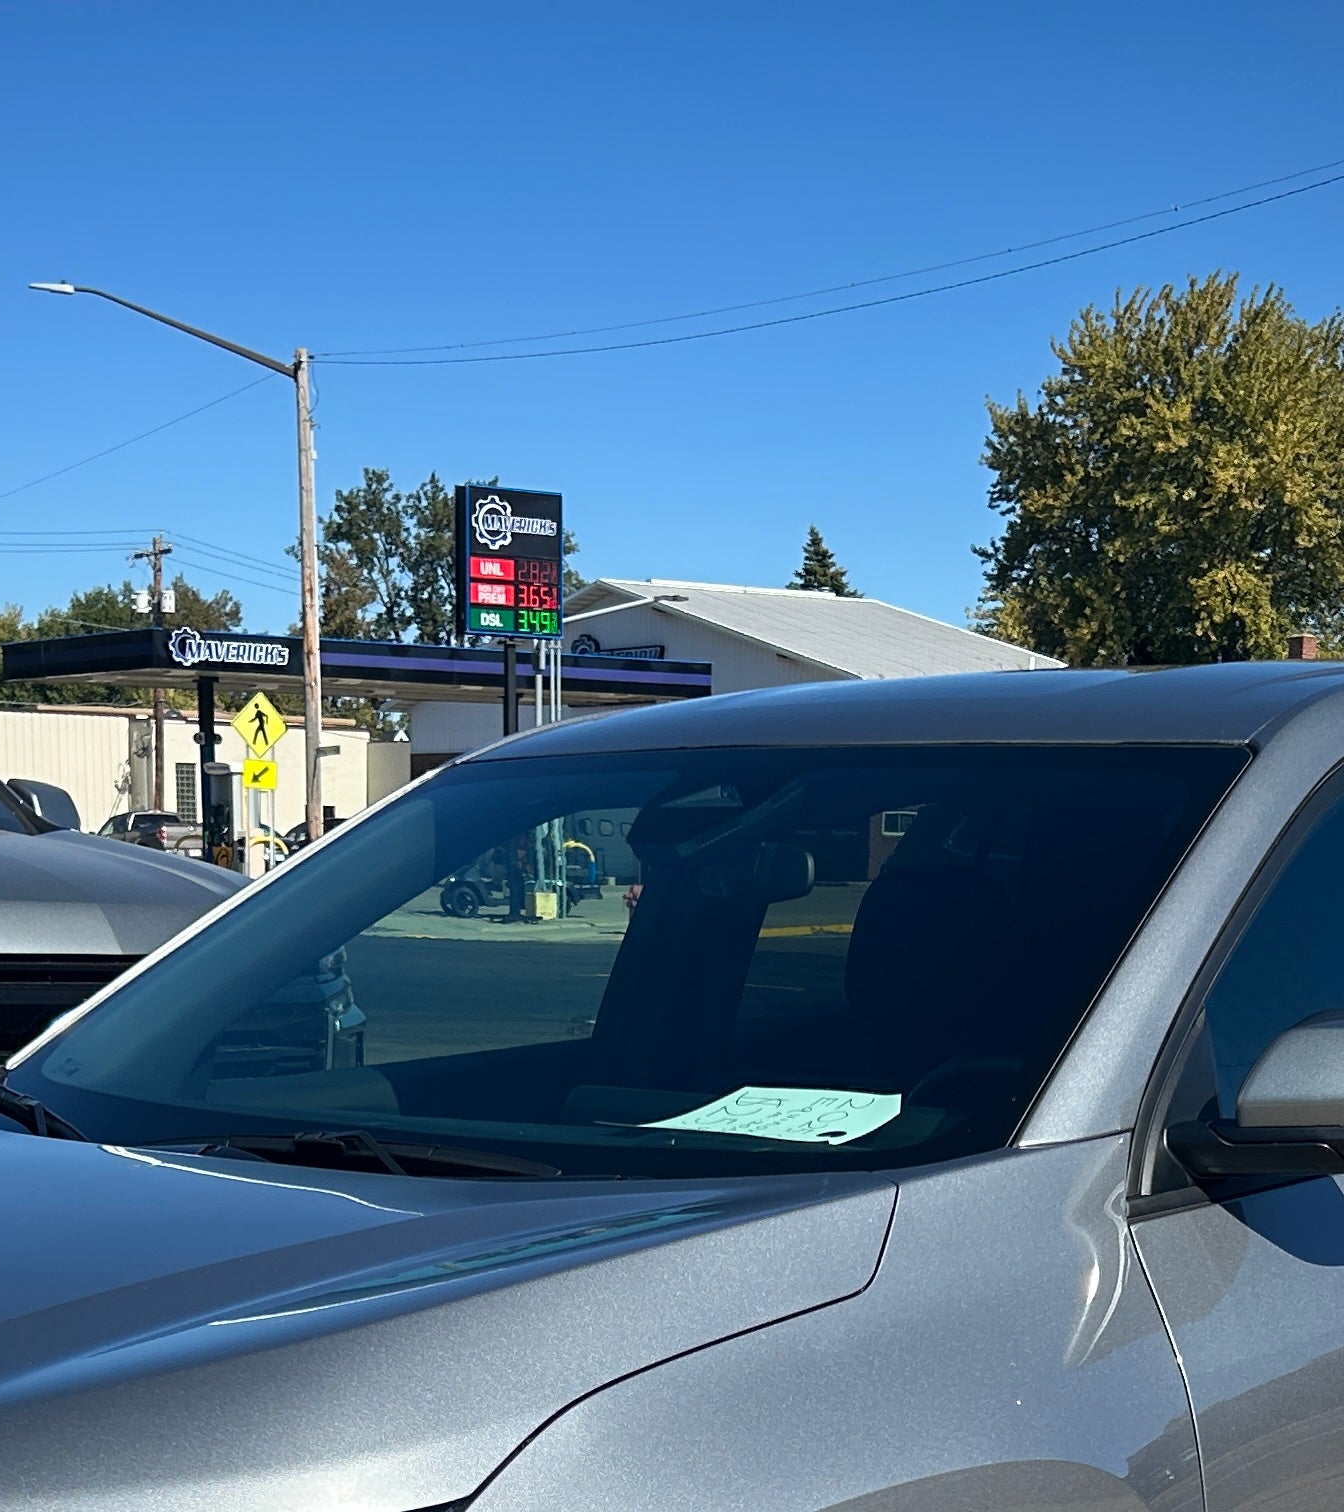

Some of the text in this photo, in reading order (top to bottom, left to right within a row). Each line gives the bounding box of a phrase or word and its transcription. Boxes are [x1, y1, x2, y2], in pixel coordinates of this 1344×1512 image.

[479, 561, 504, 577] UNL
[478, 593, 507, 605] PREM
[480, 612, 504, 627] DSL
